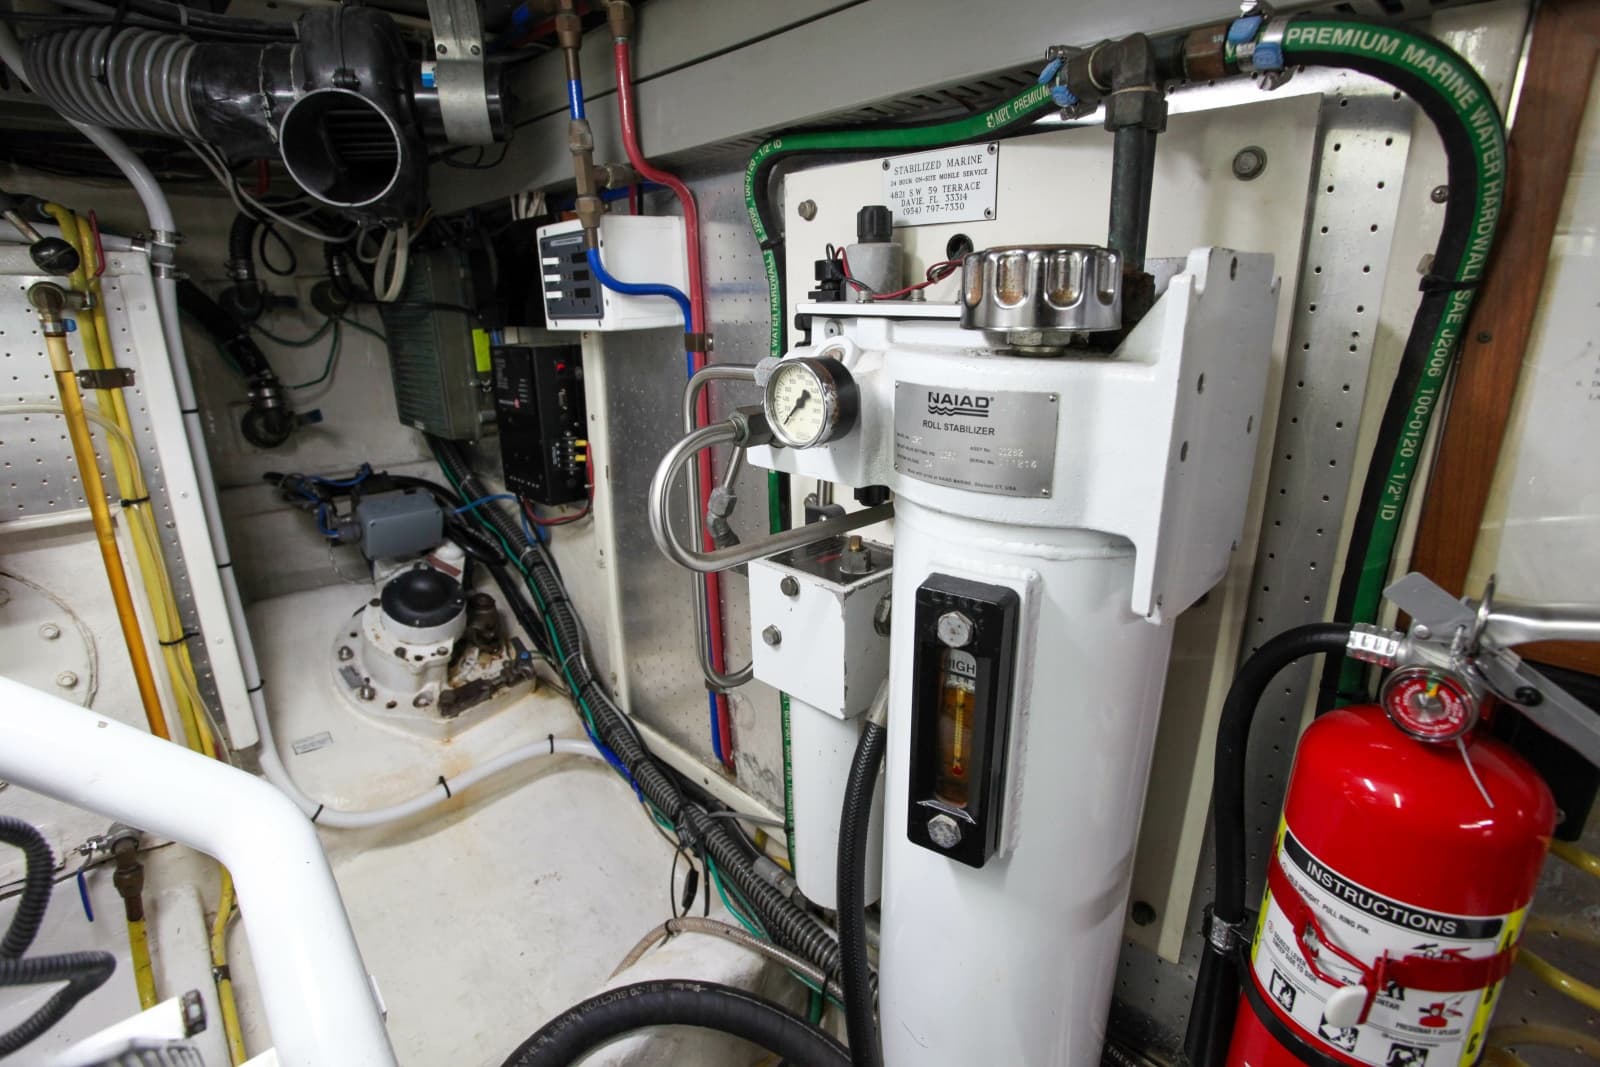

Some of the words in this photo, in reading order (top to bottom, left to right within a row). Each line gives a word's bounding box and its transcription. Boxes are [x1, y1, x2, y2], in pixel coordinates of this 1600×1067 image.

[1286, 27, 1400, 56] PREMIUM
[1401, 44, 1478, 110] MARINE
[1014, 84, 1050, 113] PREMIUM
[774, 139, 782, 149] ID
[1469, 104, 1500, 178] WATER
[894, 160, 942, 176] STABILIZED
[946, 154, 982, 168] MARINE
[915, 174, 936, 184] ON-SITE
[940, 171, 960, 180] MOBILE
[963, 168, 988, 178] SERVICE
[745, 159, 756, 200] 100-0120
[942, 181, 980, 192] TERRACE
[748, 208, 762, 234] J2006
[1461, 181, 1500, 282] HARDWALL
[766, 255, 778, 312] HARDWALL
[1446, 290, 1472, 324] SAE
[1428, 329, 1455, 376] J2006
[928, 392, 990, 408] NAIAD
[922, 420, 942, 430] ROLL
[944, 423, 995, 436] STABILIZER
[1400, 388, 1434, 458] 100-0120
[1388, 473, 1406, 501] 1/2"
[1380, 504, 1398, 520] ID
[950, 660, 976, 675] IGH
[1306, 861, 1457, 934] INSTRUCTIONS
[1322, 904, 1338, 918] PULL
